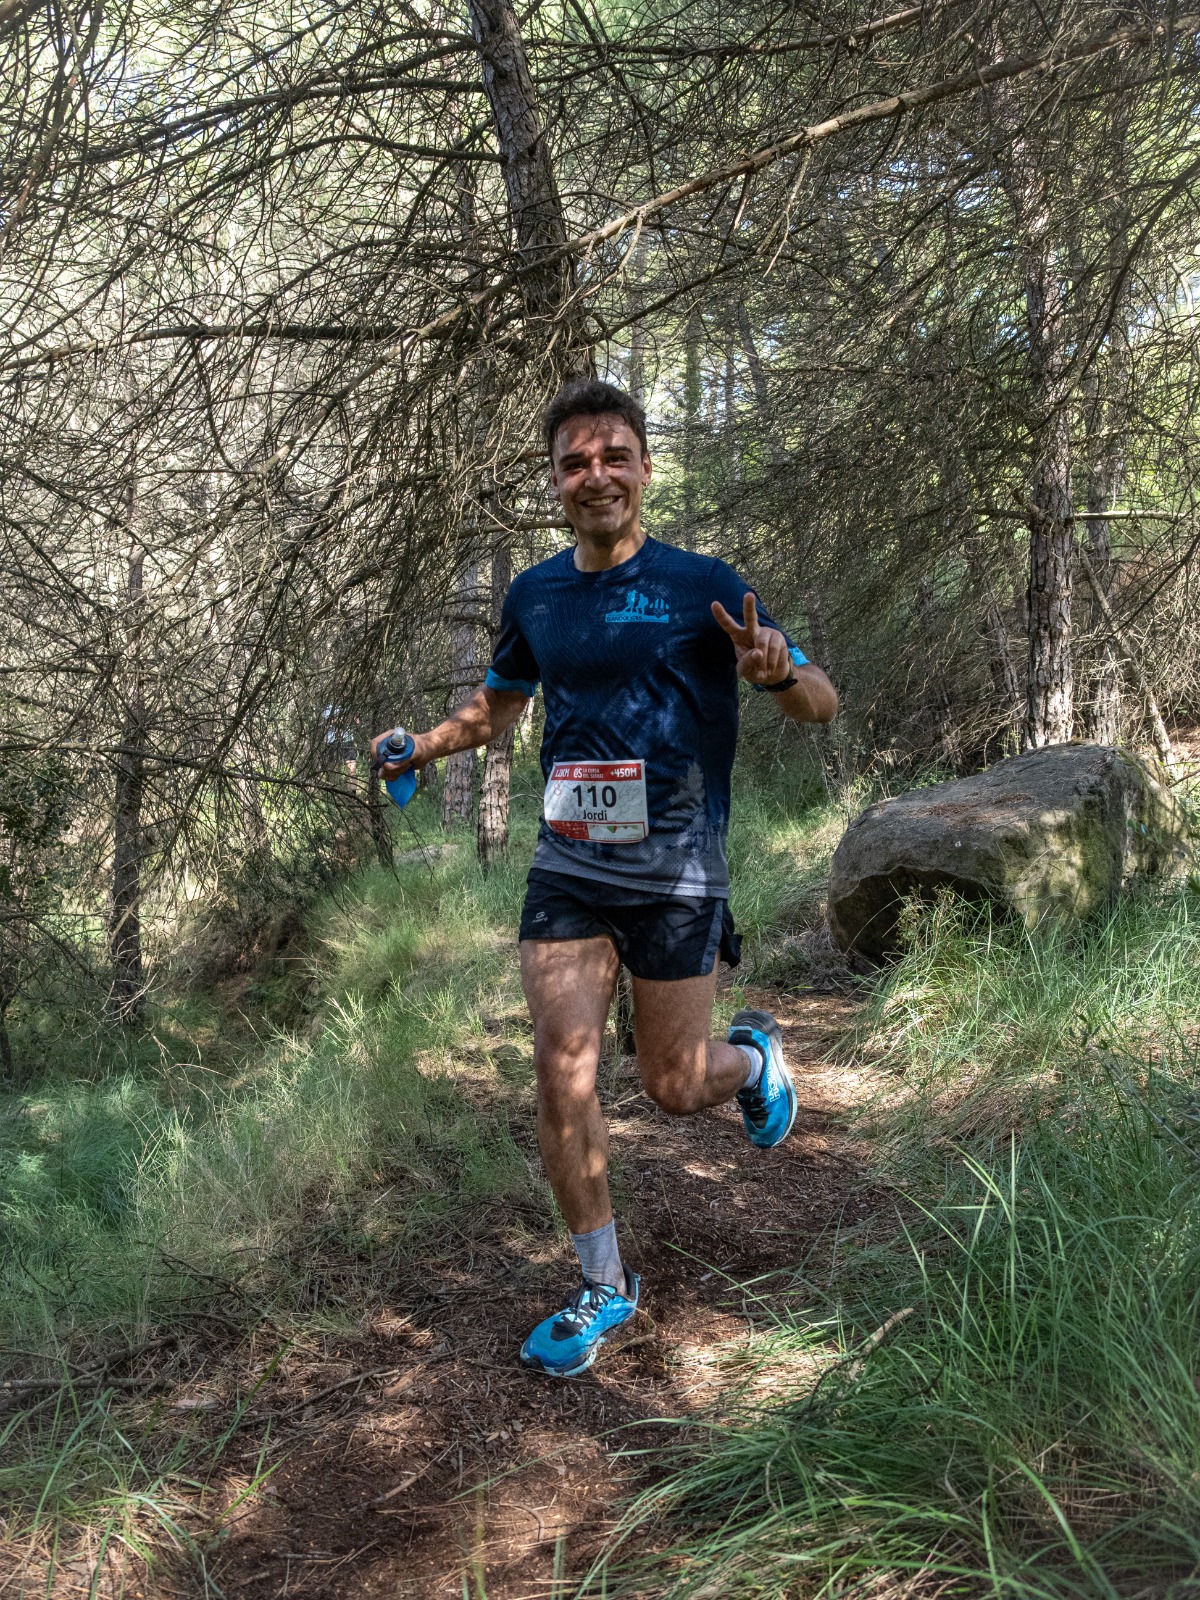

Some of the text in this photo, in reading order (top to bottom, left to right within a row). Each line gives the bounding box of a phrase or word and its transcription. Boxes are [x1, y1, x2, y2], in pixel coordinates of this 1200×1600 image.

[610, 767, 637, 778] +450M
[572, 784, 617, 808] 110
[582, 810, 608, 821] Jordi
